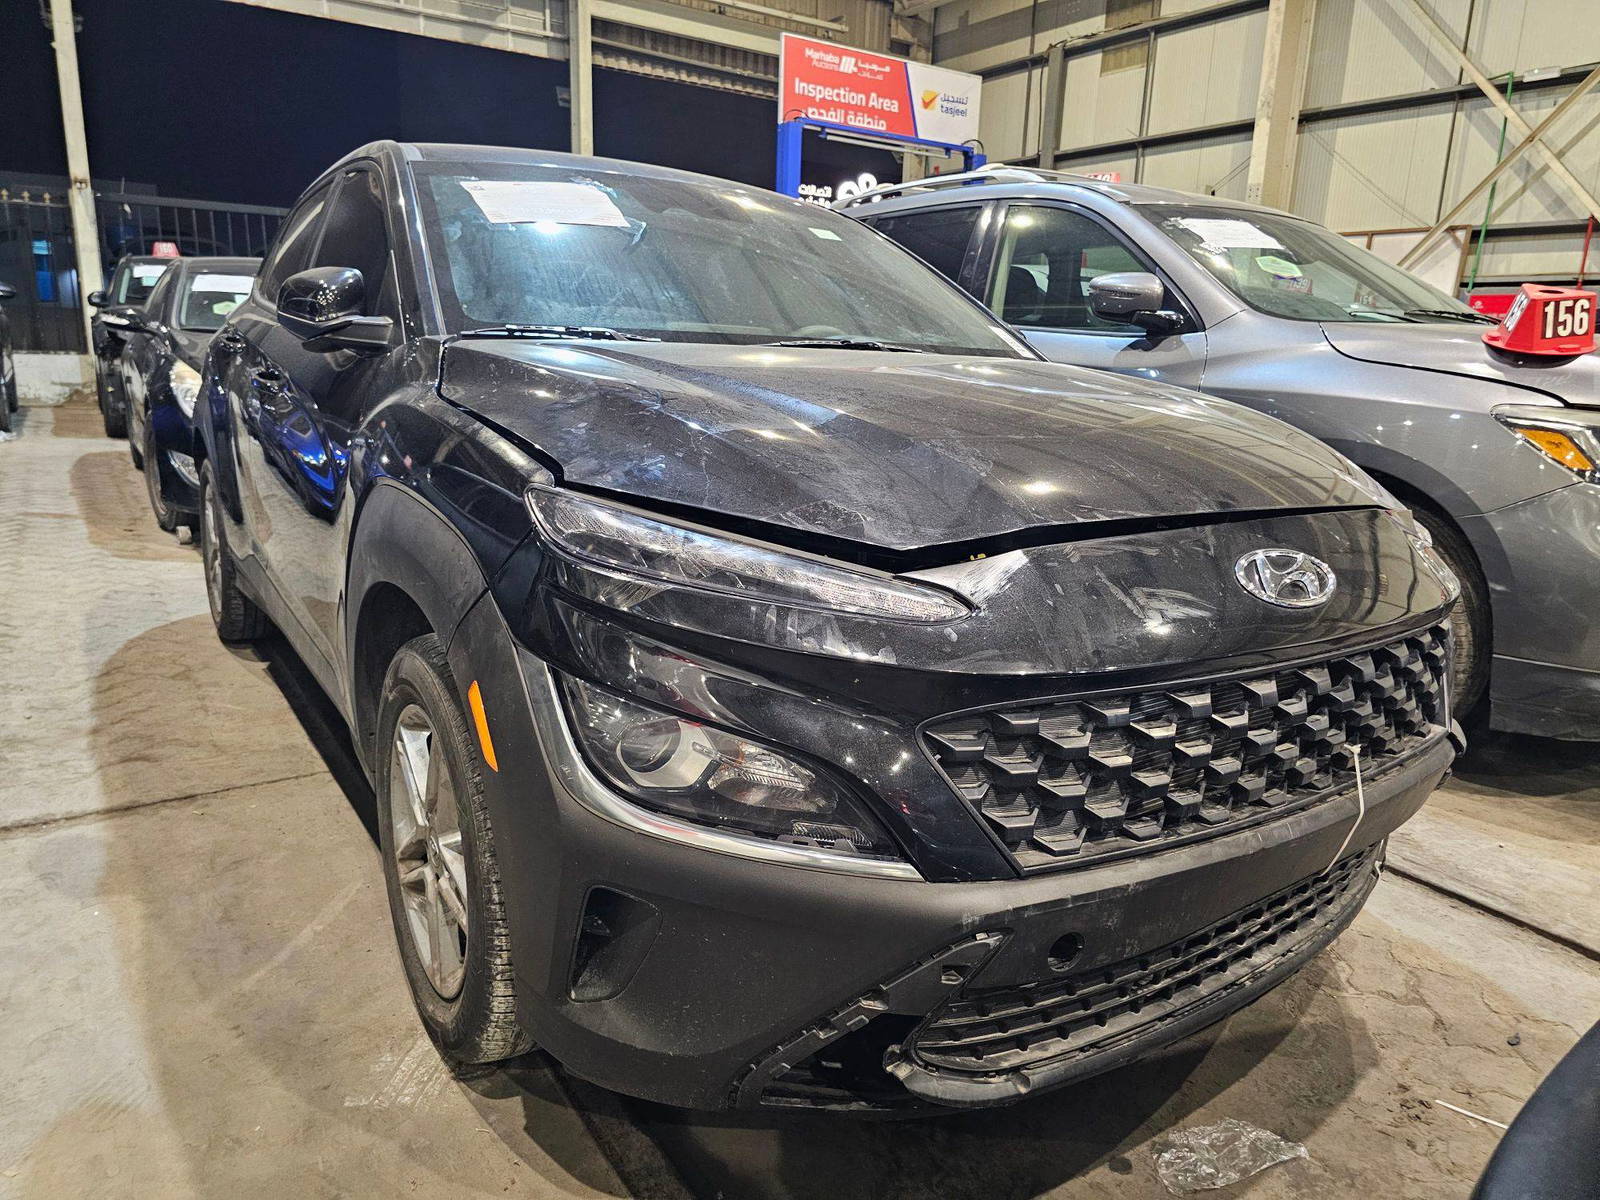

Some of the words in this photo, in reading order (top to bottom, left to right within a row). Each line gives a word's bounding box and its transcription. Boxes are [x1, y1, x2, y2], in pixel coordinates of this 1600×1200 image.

[795, 77, 866, 106] Inspection
[868, 92, 899, 112] Area
[940, 93, 968, 105] تسجيل
[940, 105, 968, 118] tasjeel
[1545, 298, 1590, 339] 156
